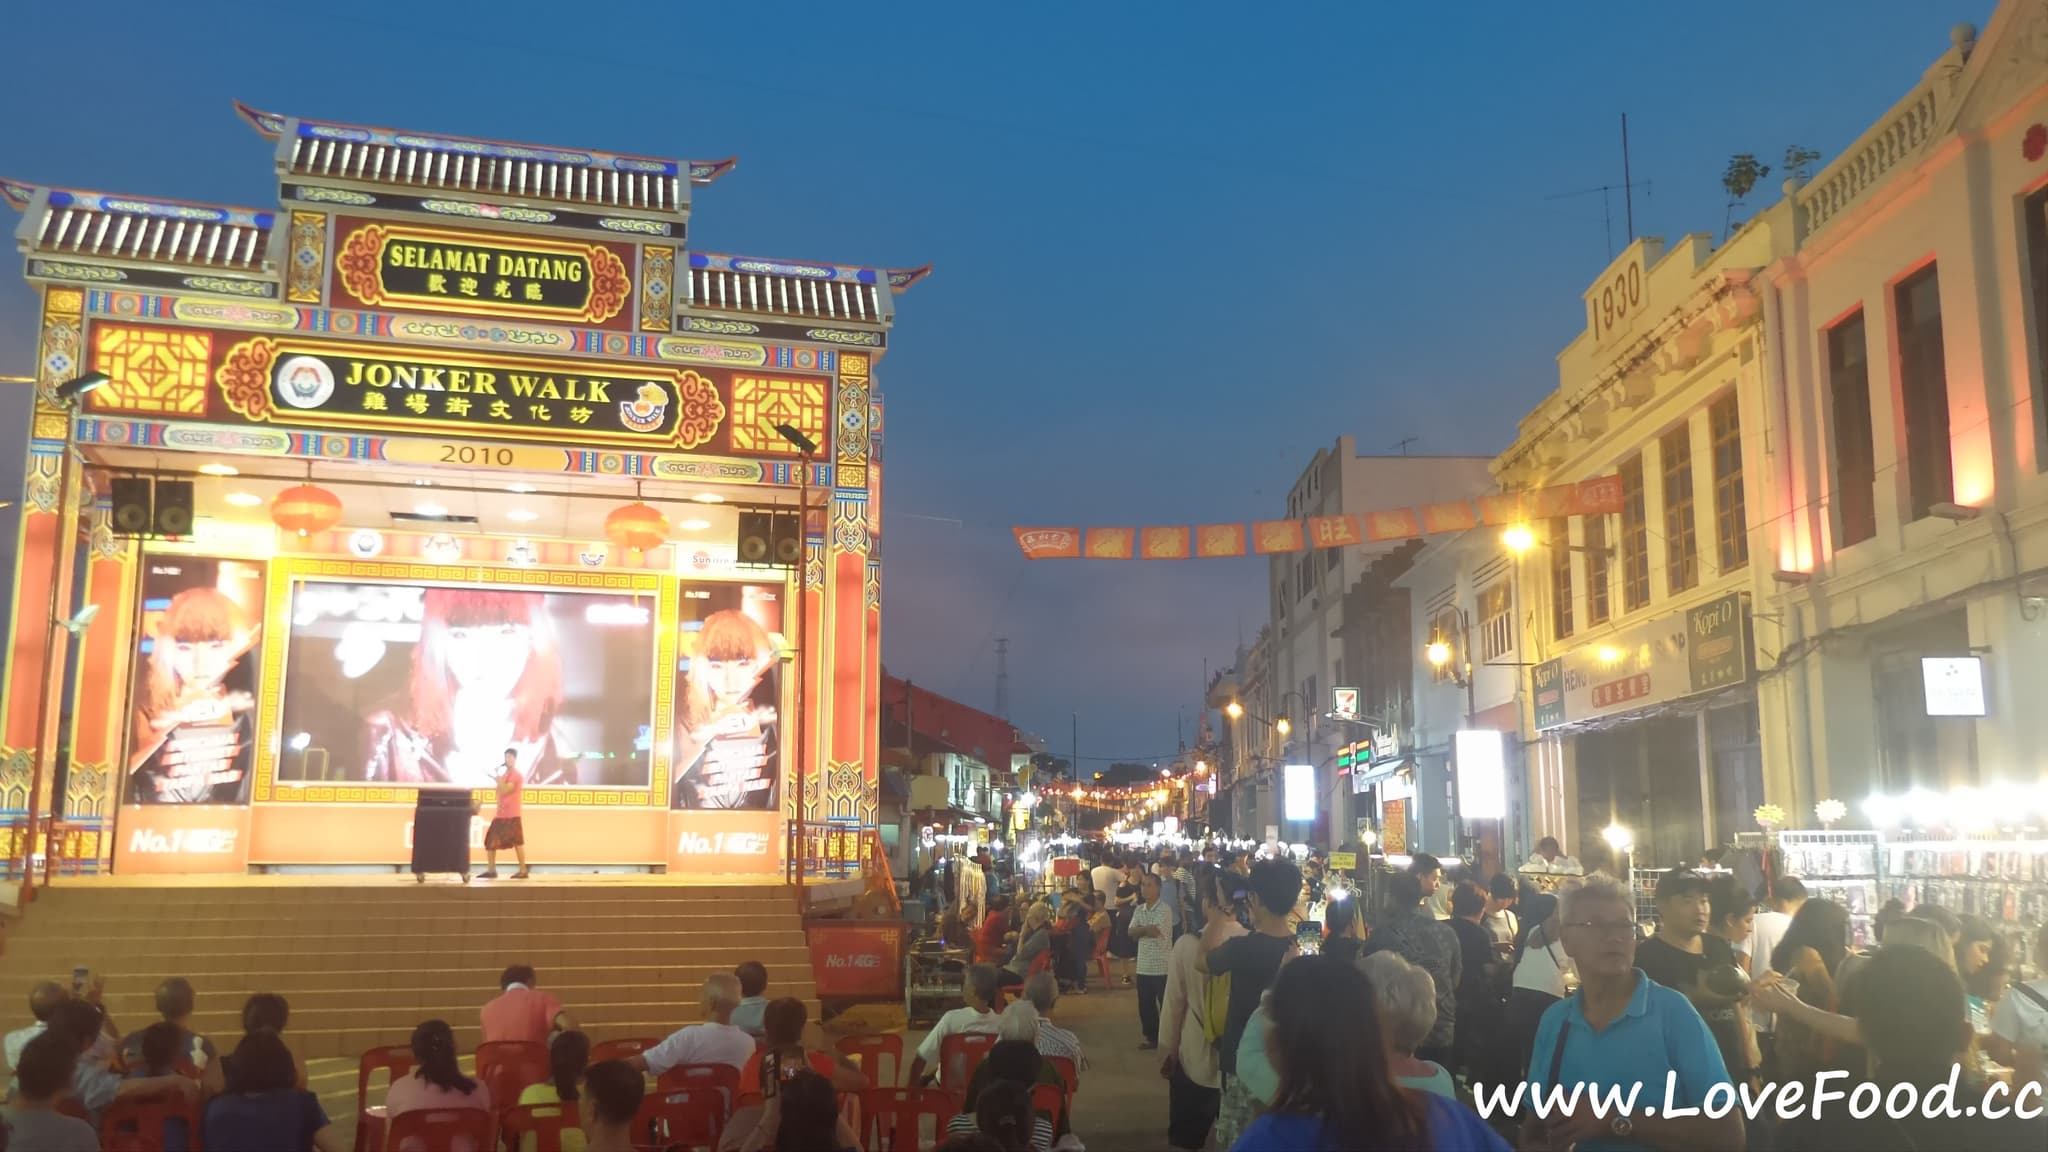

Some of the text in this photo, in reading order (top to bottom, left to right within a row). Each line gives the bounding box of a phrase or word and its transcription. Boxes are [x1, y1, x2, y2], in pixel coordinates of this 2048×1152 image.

[390, 245, 582, 282] SELAMAT DATANG
[1593, 261, 1640, 342] 1930
[345, 362, 612, 403] JONKER WALK
[440, 445, 513, 466] 2010
[1319, 521, 1352, 541] 旺
[1694, 609, 1719, 635] Kopi
[129, 828, 184, 853] No.1
[678, 831, 724, 855] No.1
